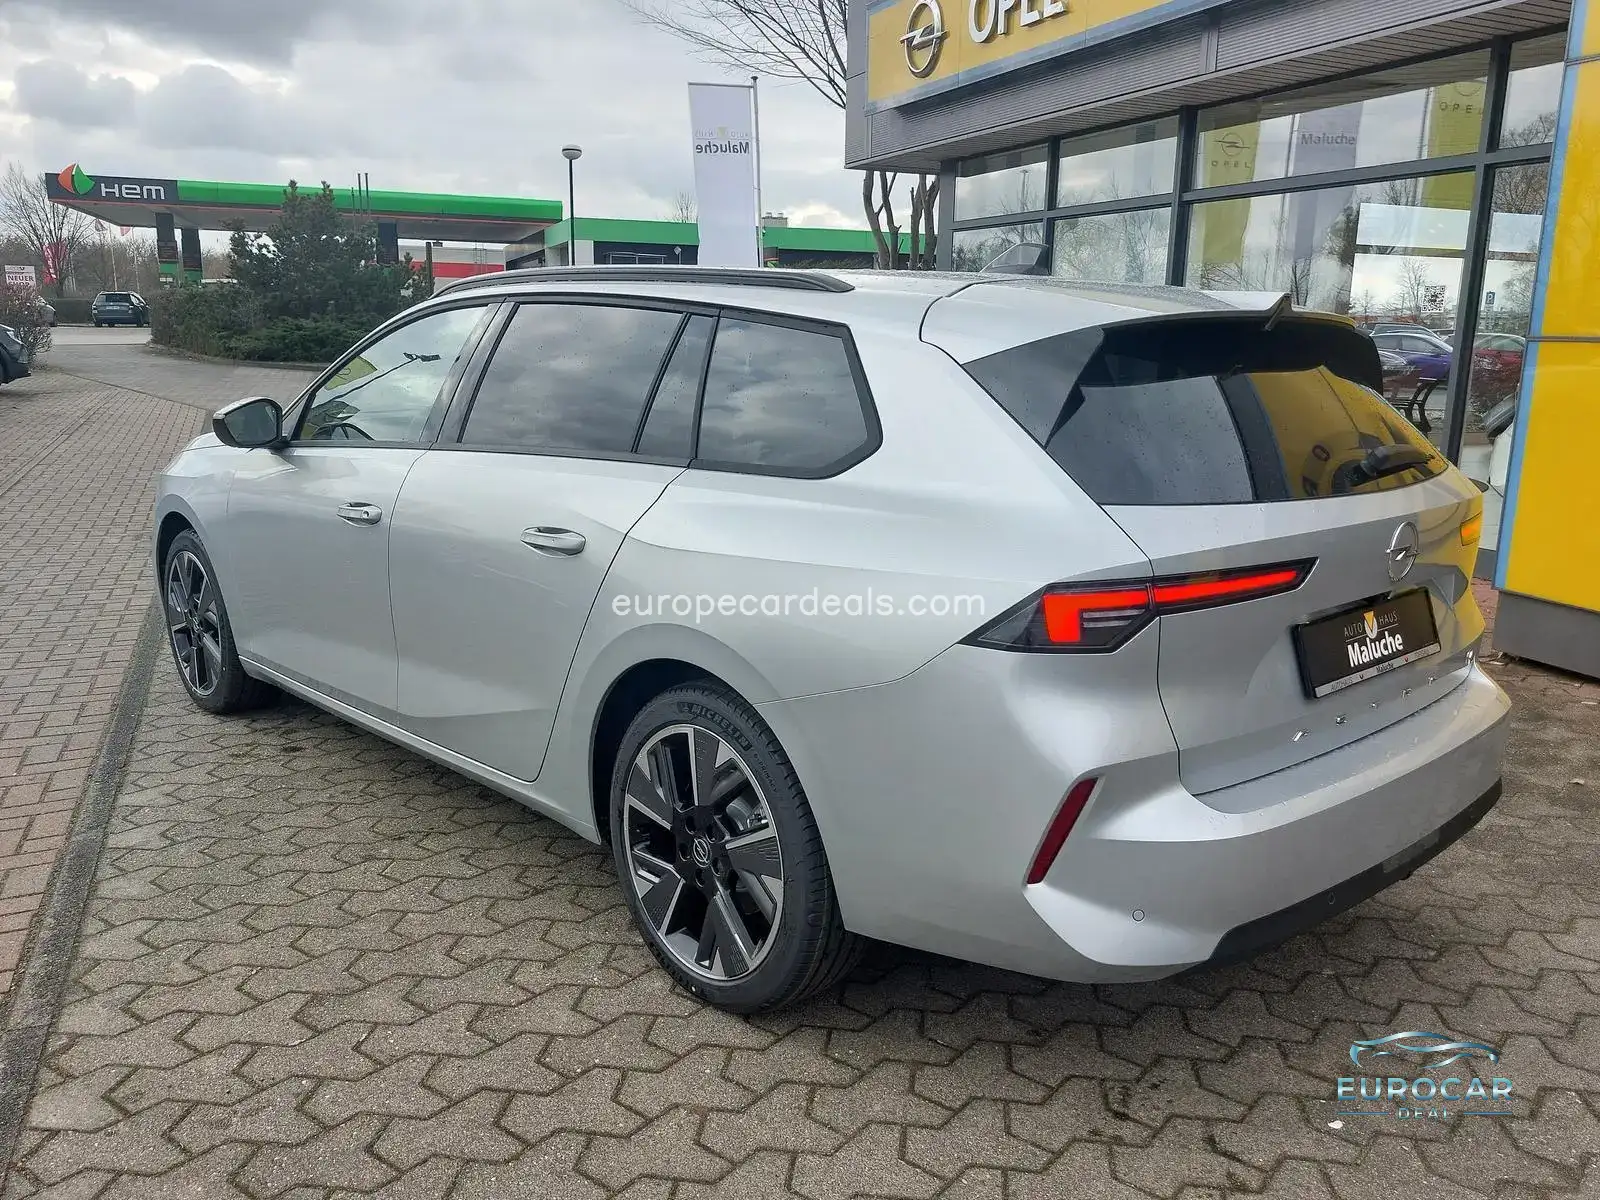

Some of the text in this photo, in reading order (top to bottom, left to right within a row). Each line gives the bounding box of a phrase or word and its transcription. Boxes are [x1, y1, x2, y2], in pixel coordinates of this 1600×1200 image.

[1301, 133, 1356, 145] Maluche
[1344, 610, 1398, 637] AUTO HAUS
[1347, 630, 1404, 668] Maluche
[691, 703, 752, 750] MICHELIN
